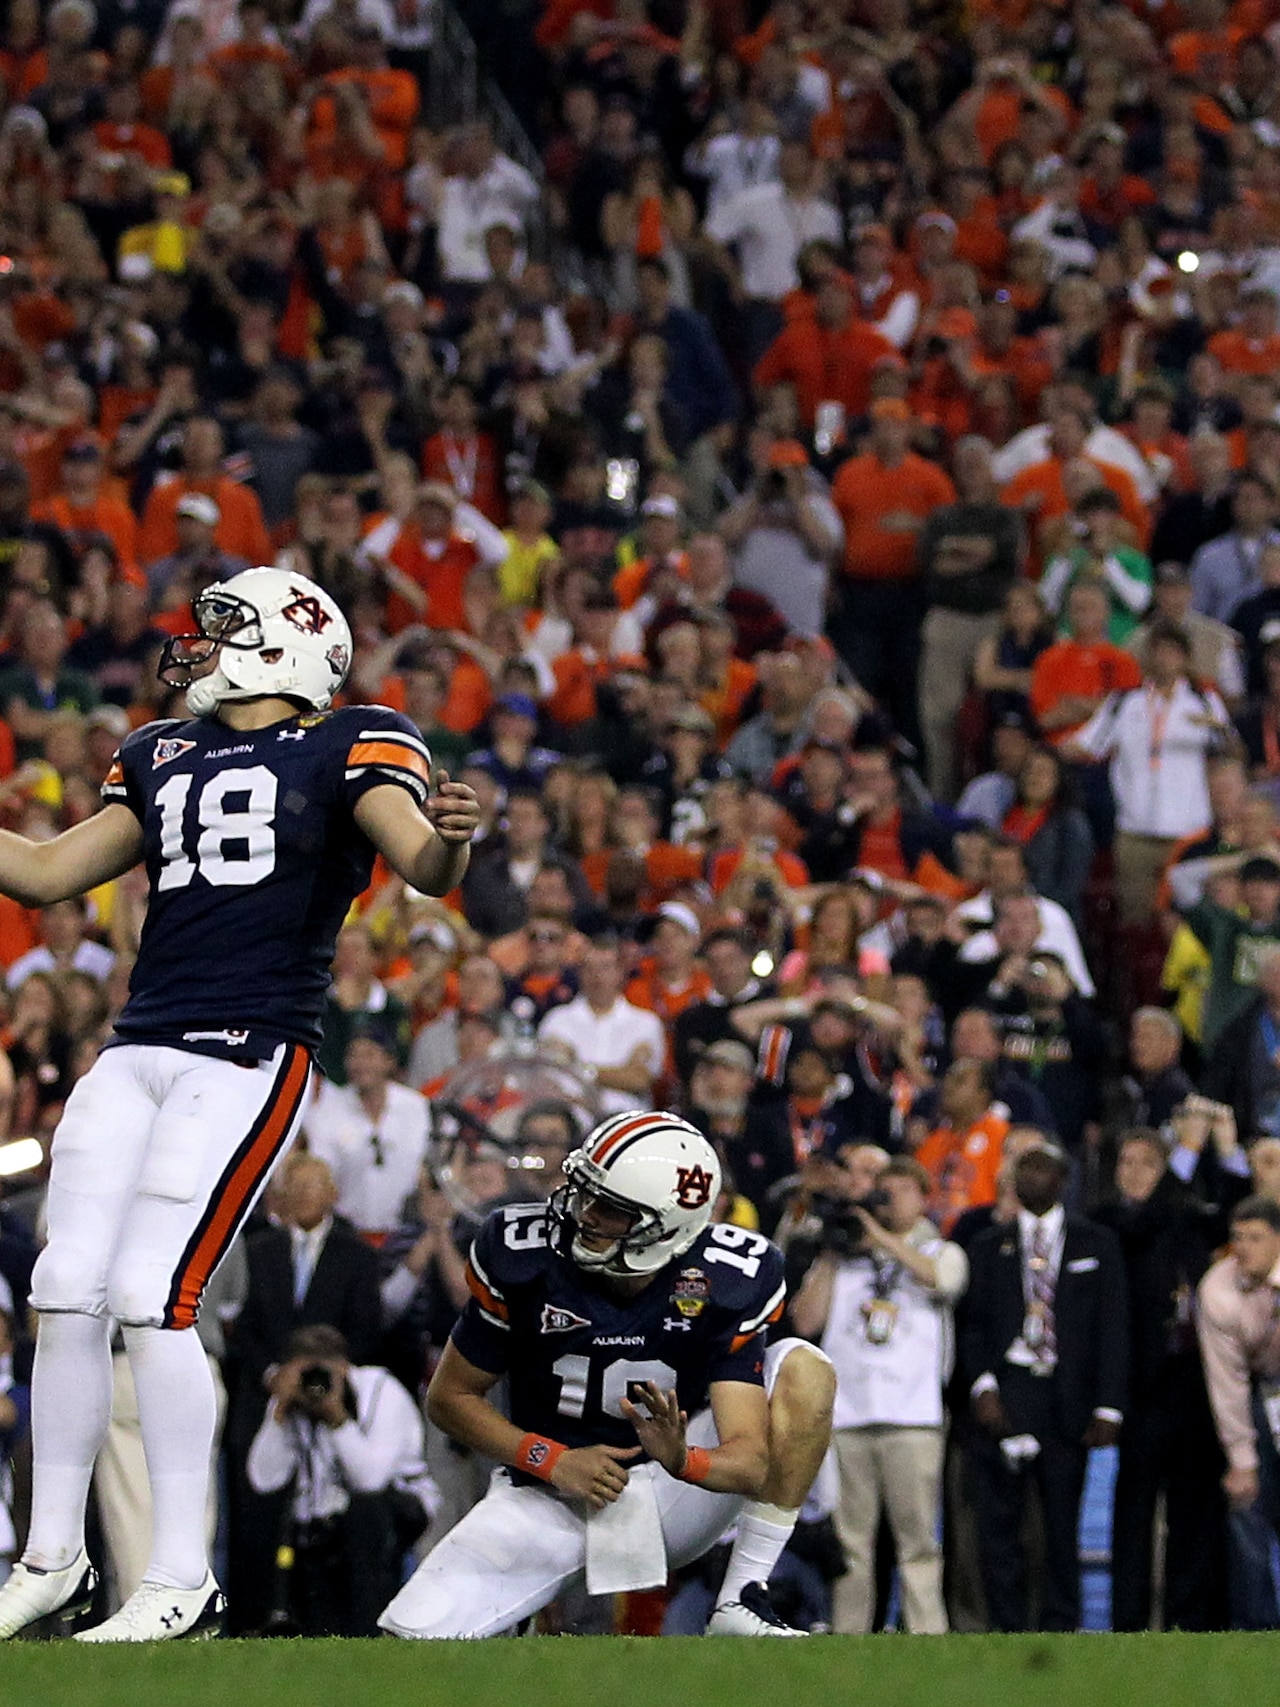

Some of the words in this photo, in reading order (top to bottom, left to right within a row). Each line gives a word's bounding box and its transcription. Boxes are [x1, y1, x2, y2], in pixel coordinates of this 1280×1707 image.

[204, 744, 254, 759] AUBURN
[155, 764, 278, 892] 18
[703, 1223, 769, 1279] 19
[592, 1335, 646, 1346] AUBURN
